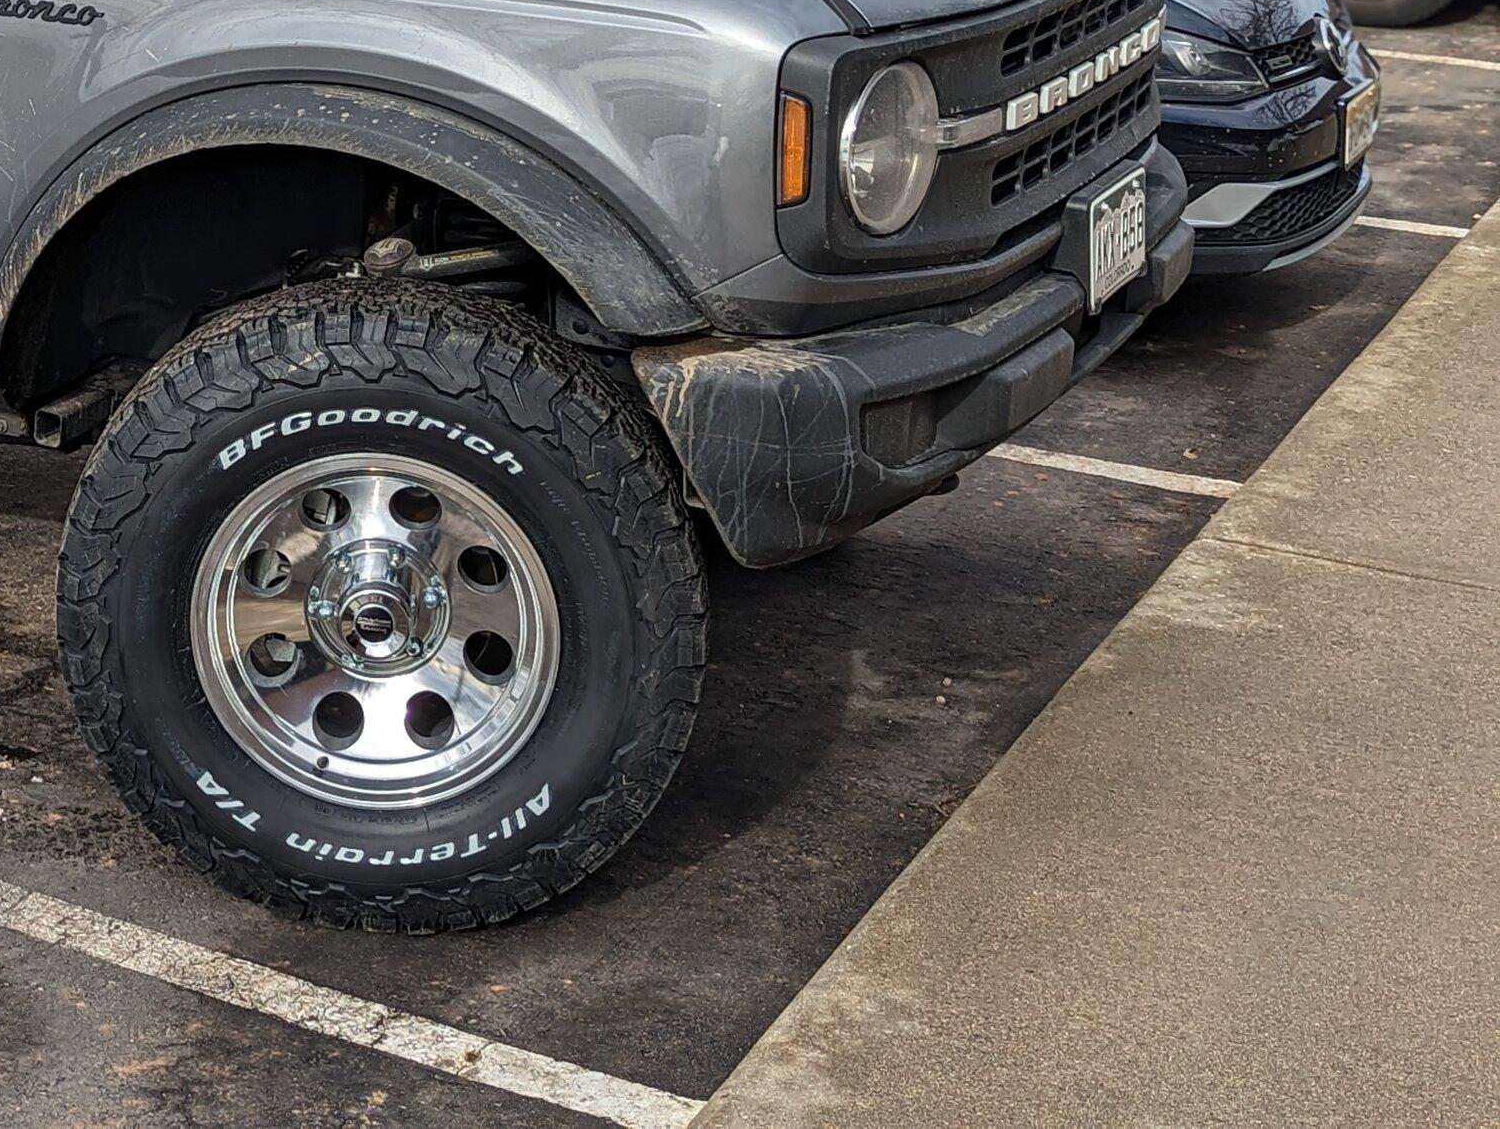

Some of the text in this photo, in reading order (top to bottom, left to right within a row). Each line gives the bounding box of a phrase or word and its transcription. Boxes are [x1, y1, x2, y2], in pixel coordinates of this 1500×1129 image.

[1006, 19, 1160, 131] BRONCO
[218, 407, 526, 476] BFGoodrich
[196, 769, 553, 865] All-Terrain T/A
